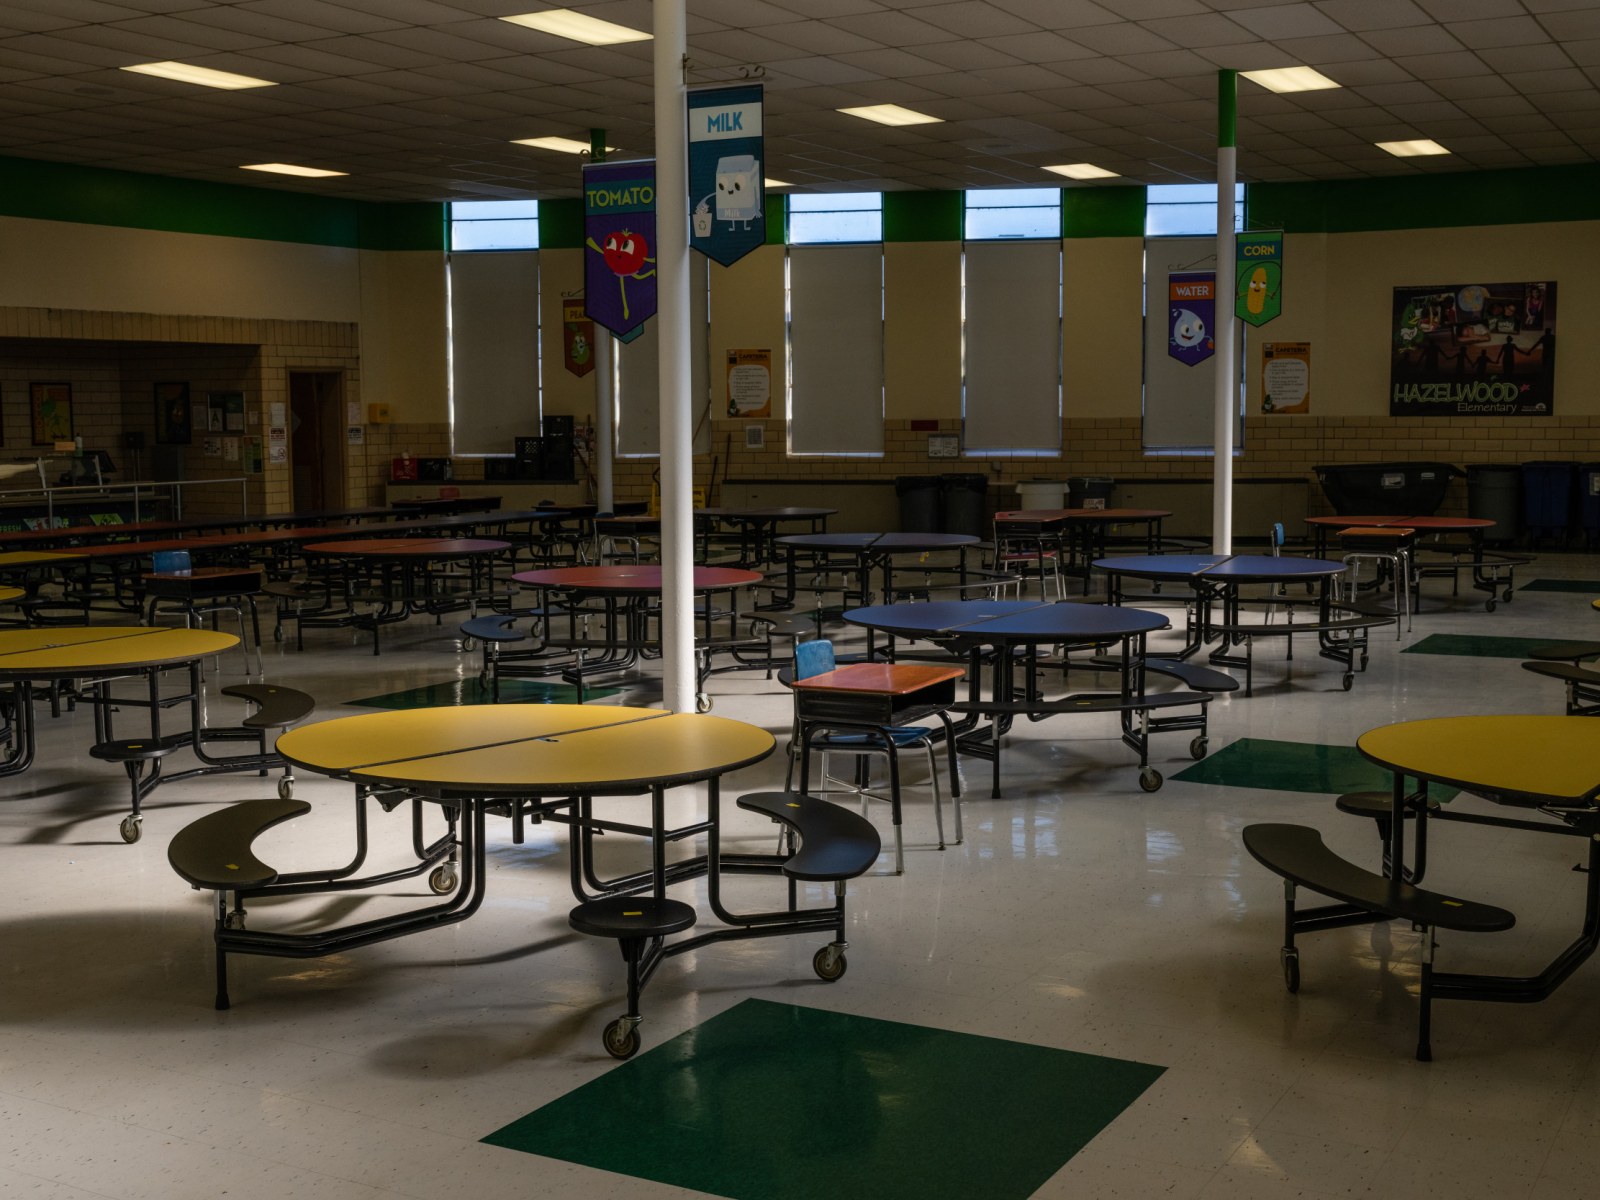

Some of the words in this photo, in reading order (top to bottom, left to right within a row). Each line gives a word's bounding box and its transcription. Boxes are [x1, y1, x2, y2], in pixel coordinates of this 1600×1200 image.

[708, 111, 743, 133] MILK
[586, 186, 654, 208] TOMATO
[724, 207, 740, 218] Milk
[1243, 245, 1275, 257] CORN
[1175, 284, 1209, 297] WATER
[570, 310, 584, 320] PEA
[1393, 380, 1519, 403] HAZELWOOD
[1457, 402, 1518, 414] Elementary
